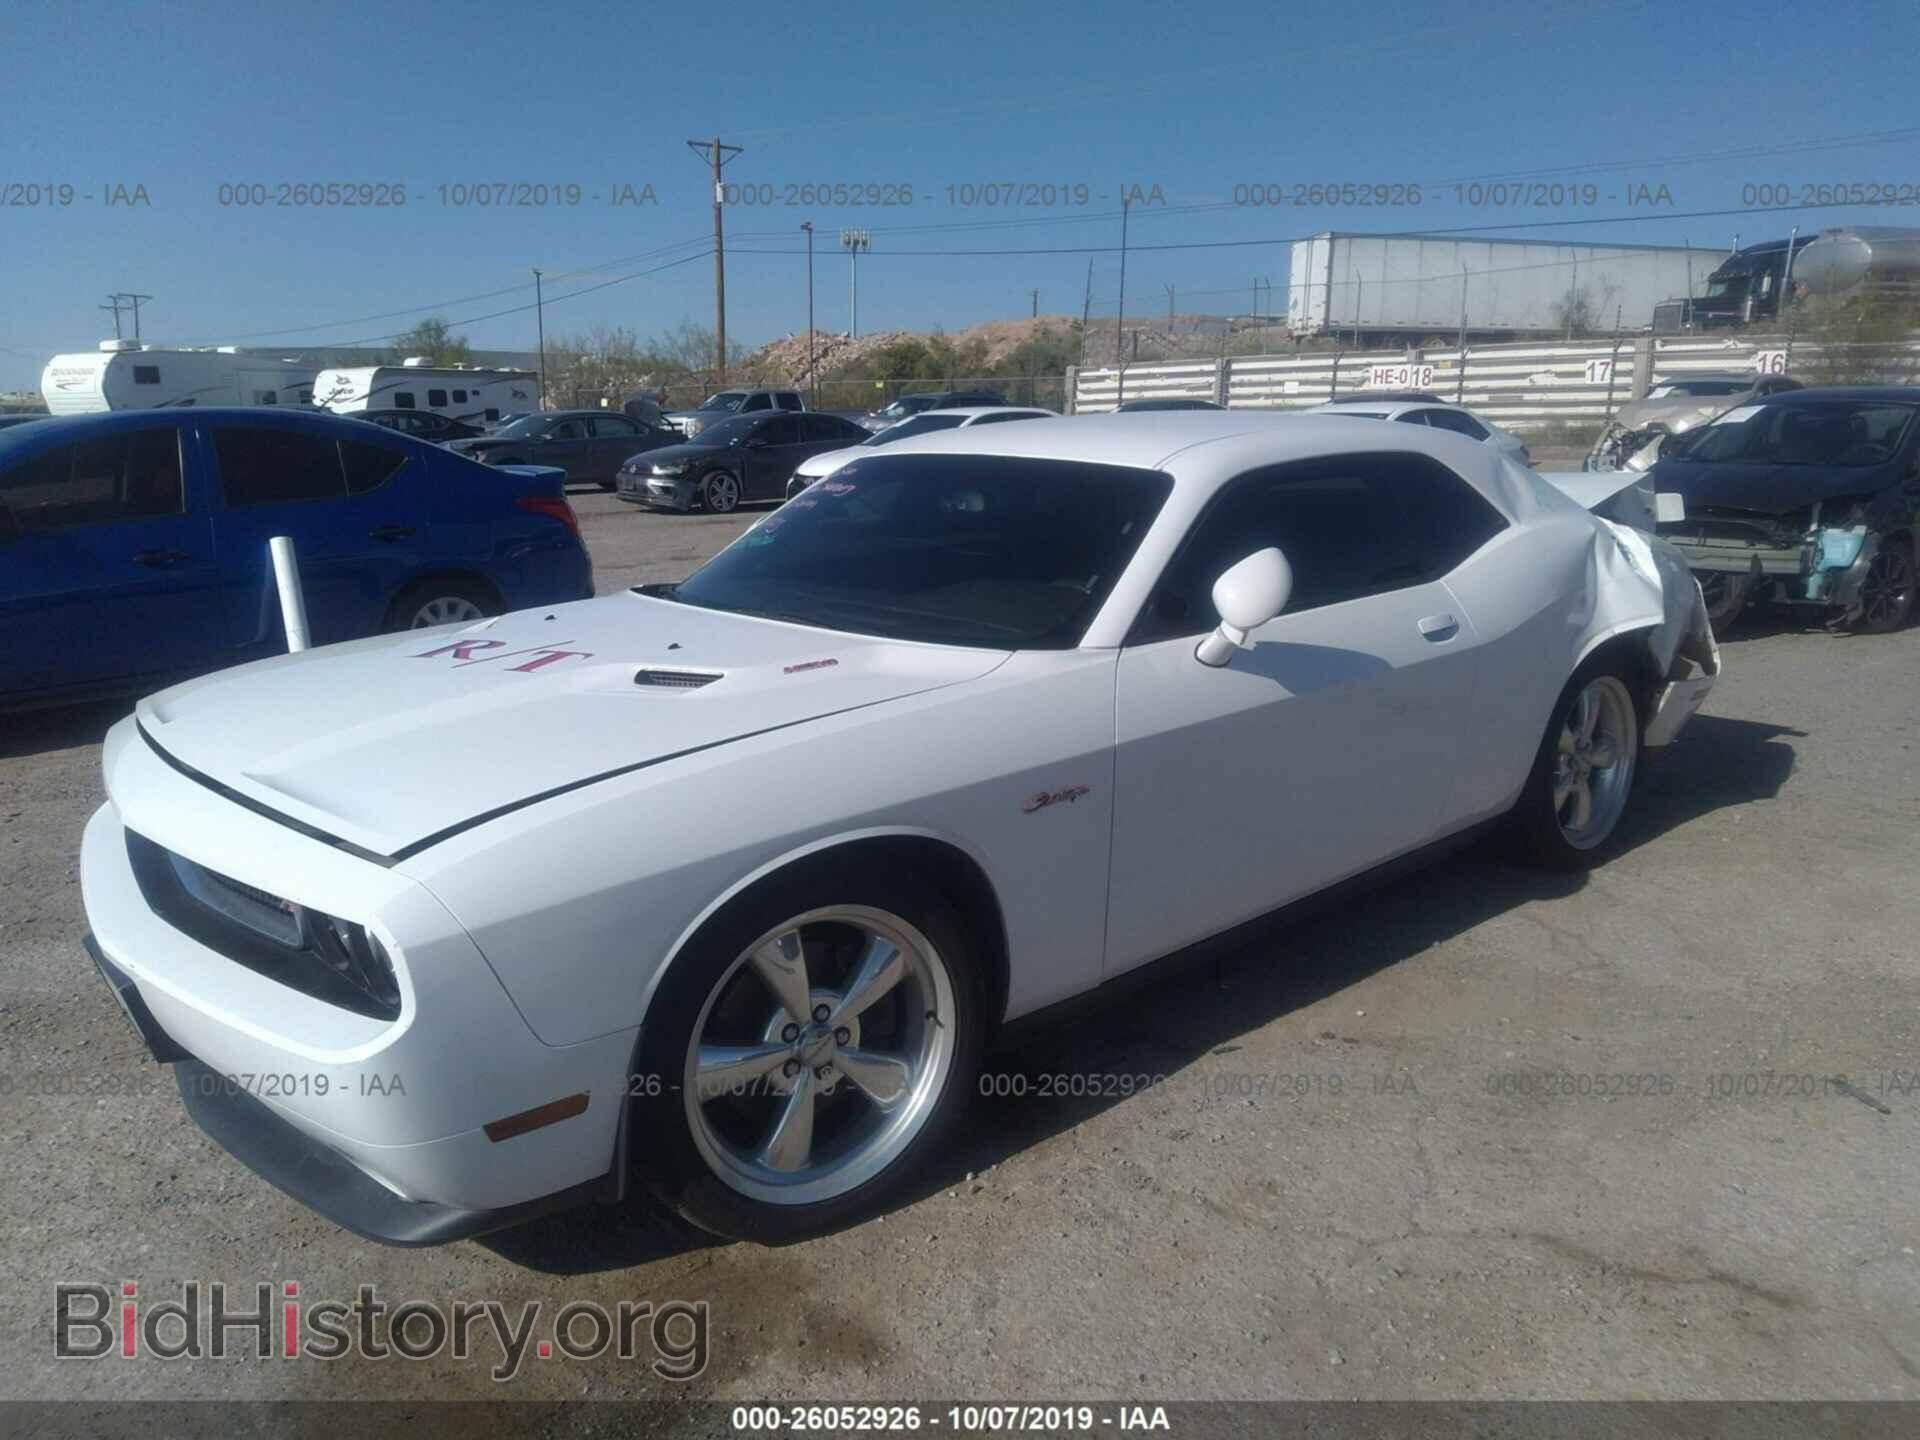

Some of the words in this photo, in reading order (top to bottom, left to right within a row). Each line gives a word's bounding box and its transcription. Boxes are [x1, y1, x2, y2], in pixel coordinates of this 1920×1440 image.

[1586, 361, 1611, 382] 17
[1759, 353, 1785, 374] 16
[403, 639, 595, 673] R/T
